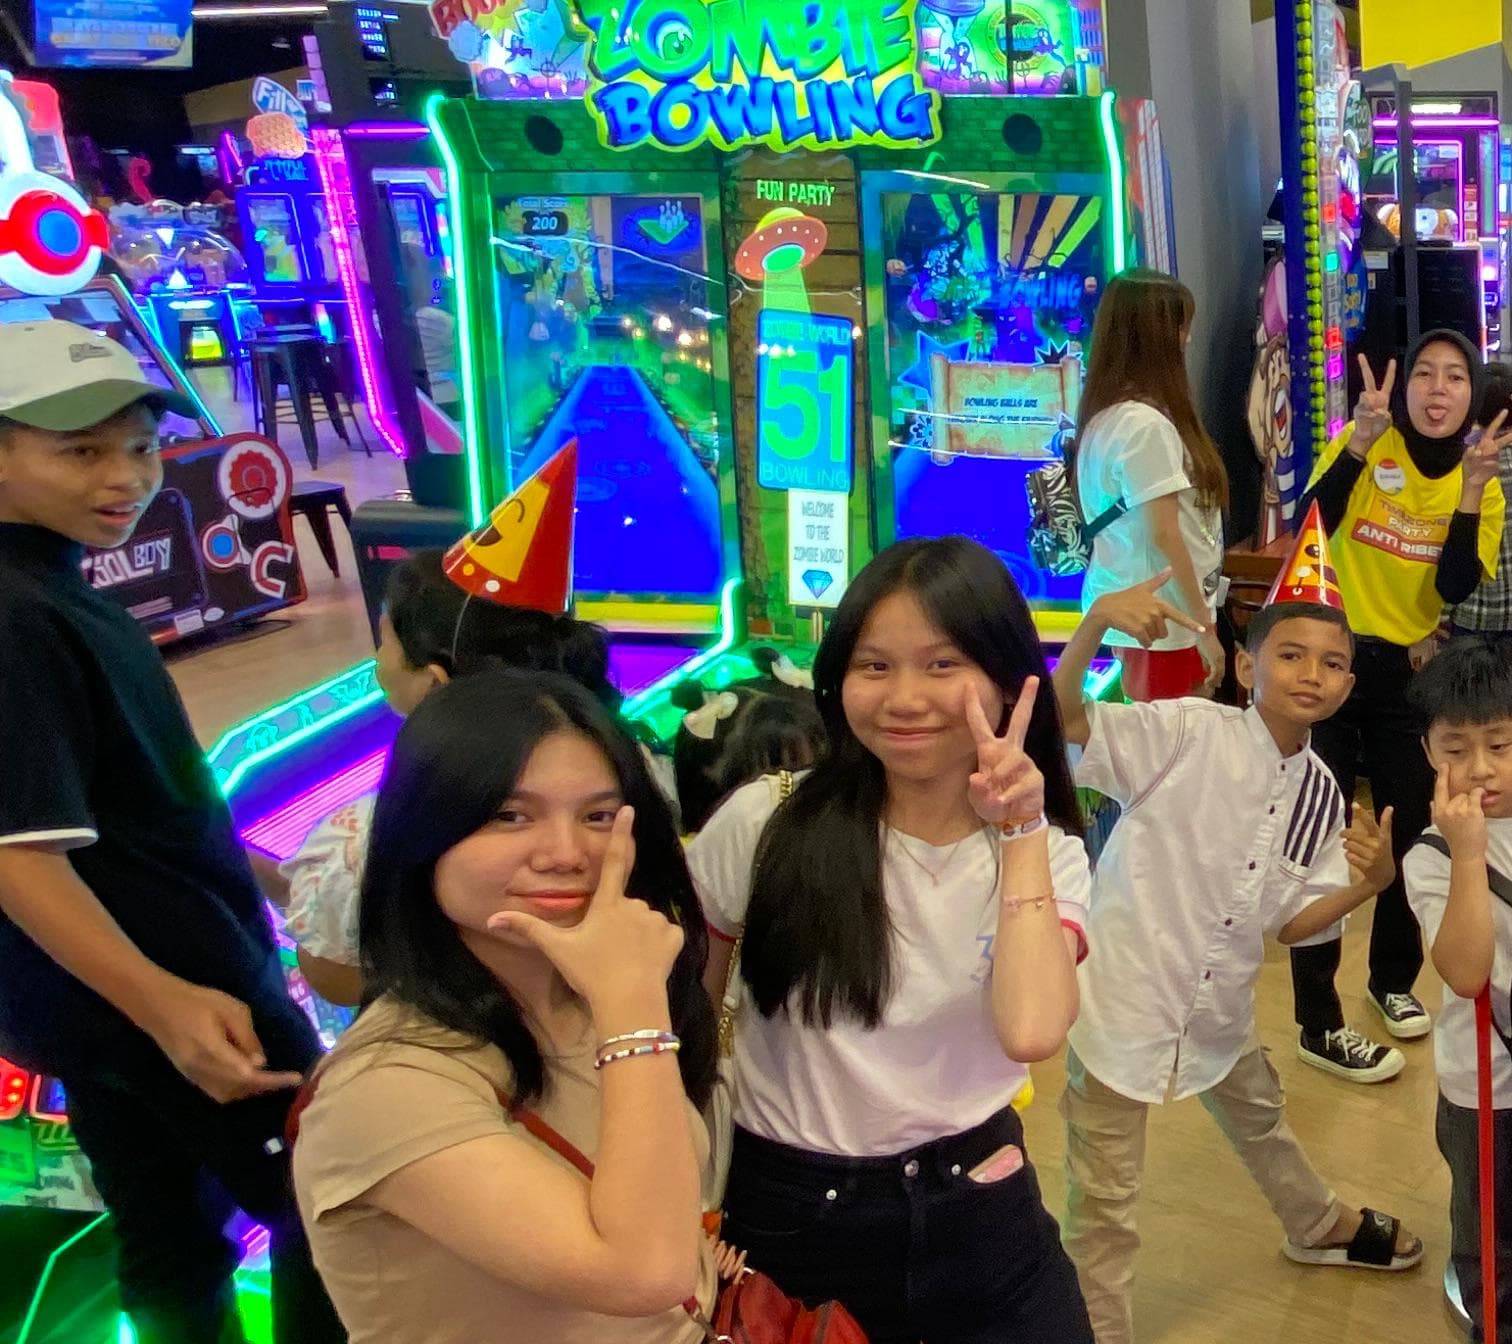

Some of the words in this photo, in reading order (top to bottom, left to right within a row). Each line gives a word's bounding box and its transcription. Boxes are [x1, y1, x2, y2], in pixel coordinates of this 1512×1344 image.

[594, 74, 934, 147] BOWLING
[756, 179, 784, 201] FUN
[788, 182, 836, 206] PARTY
[531, 216, 559, 231] 200
[763, 350, 847, 463] 51
[761, 462, 849, 489] BOWLING
[1357, 524, 1399, 548] ANTI
[133, 537, 171, 570] BOY
